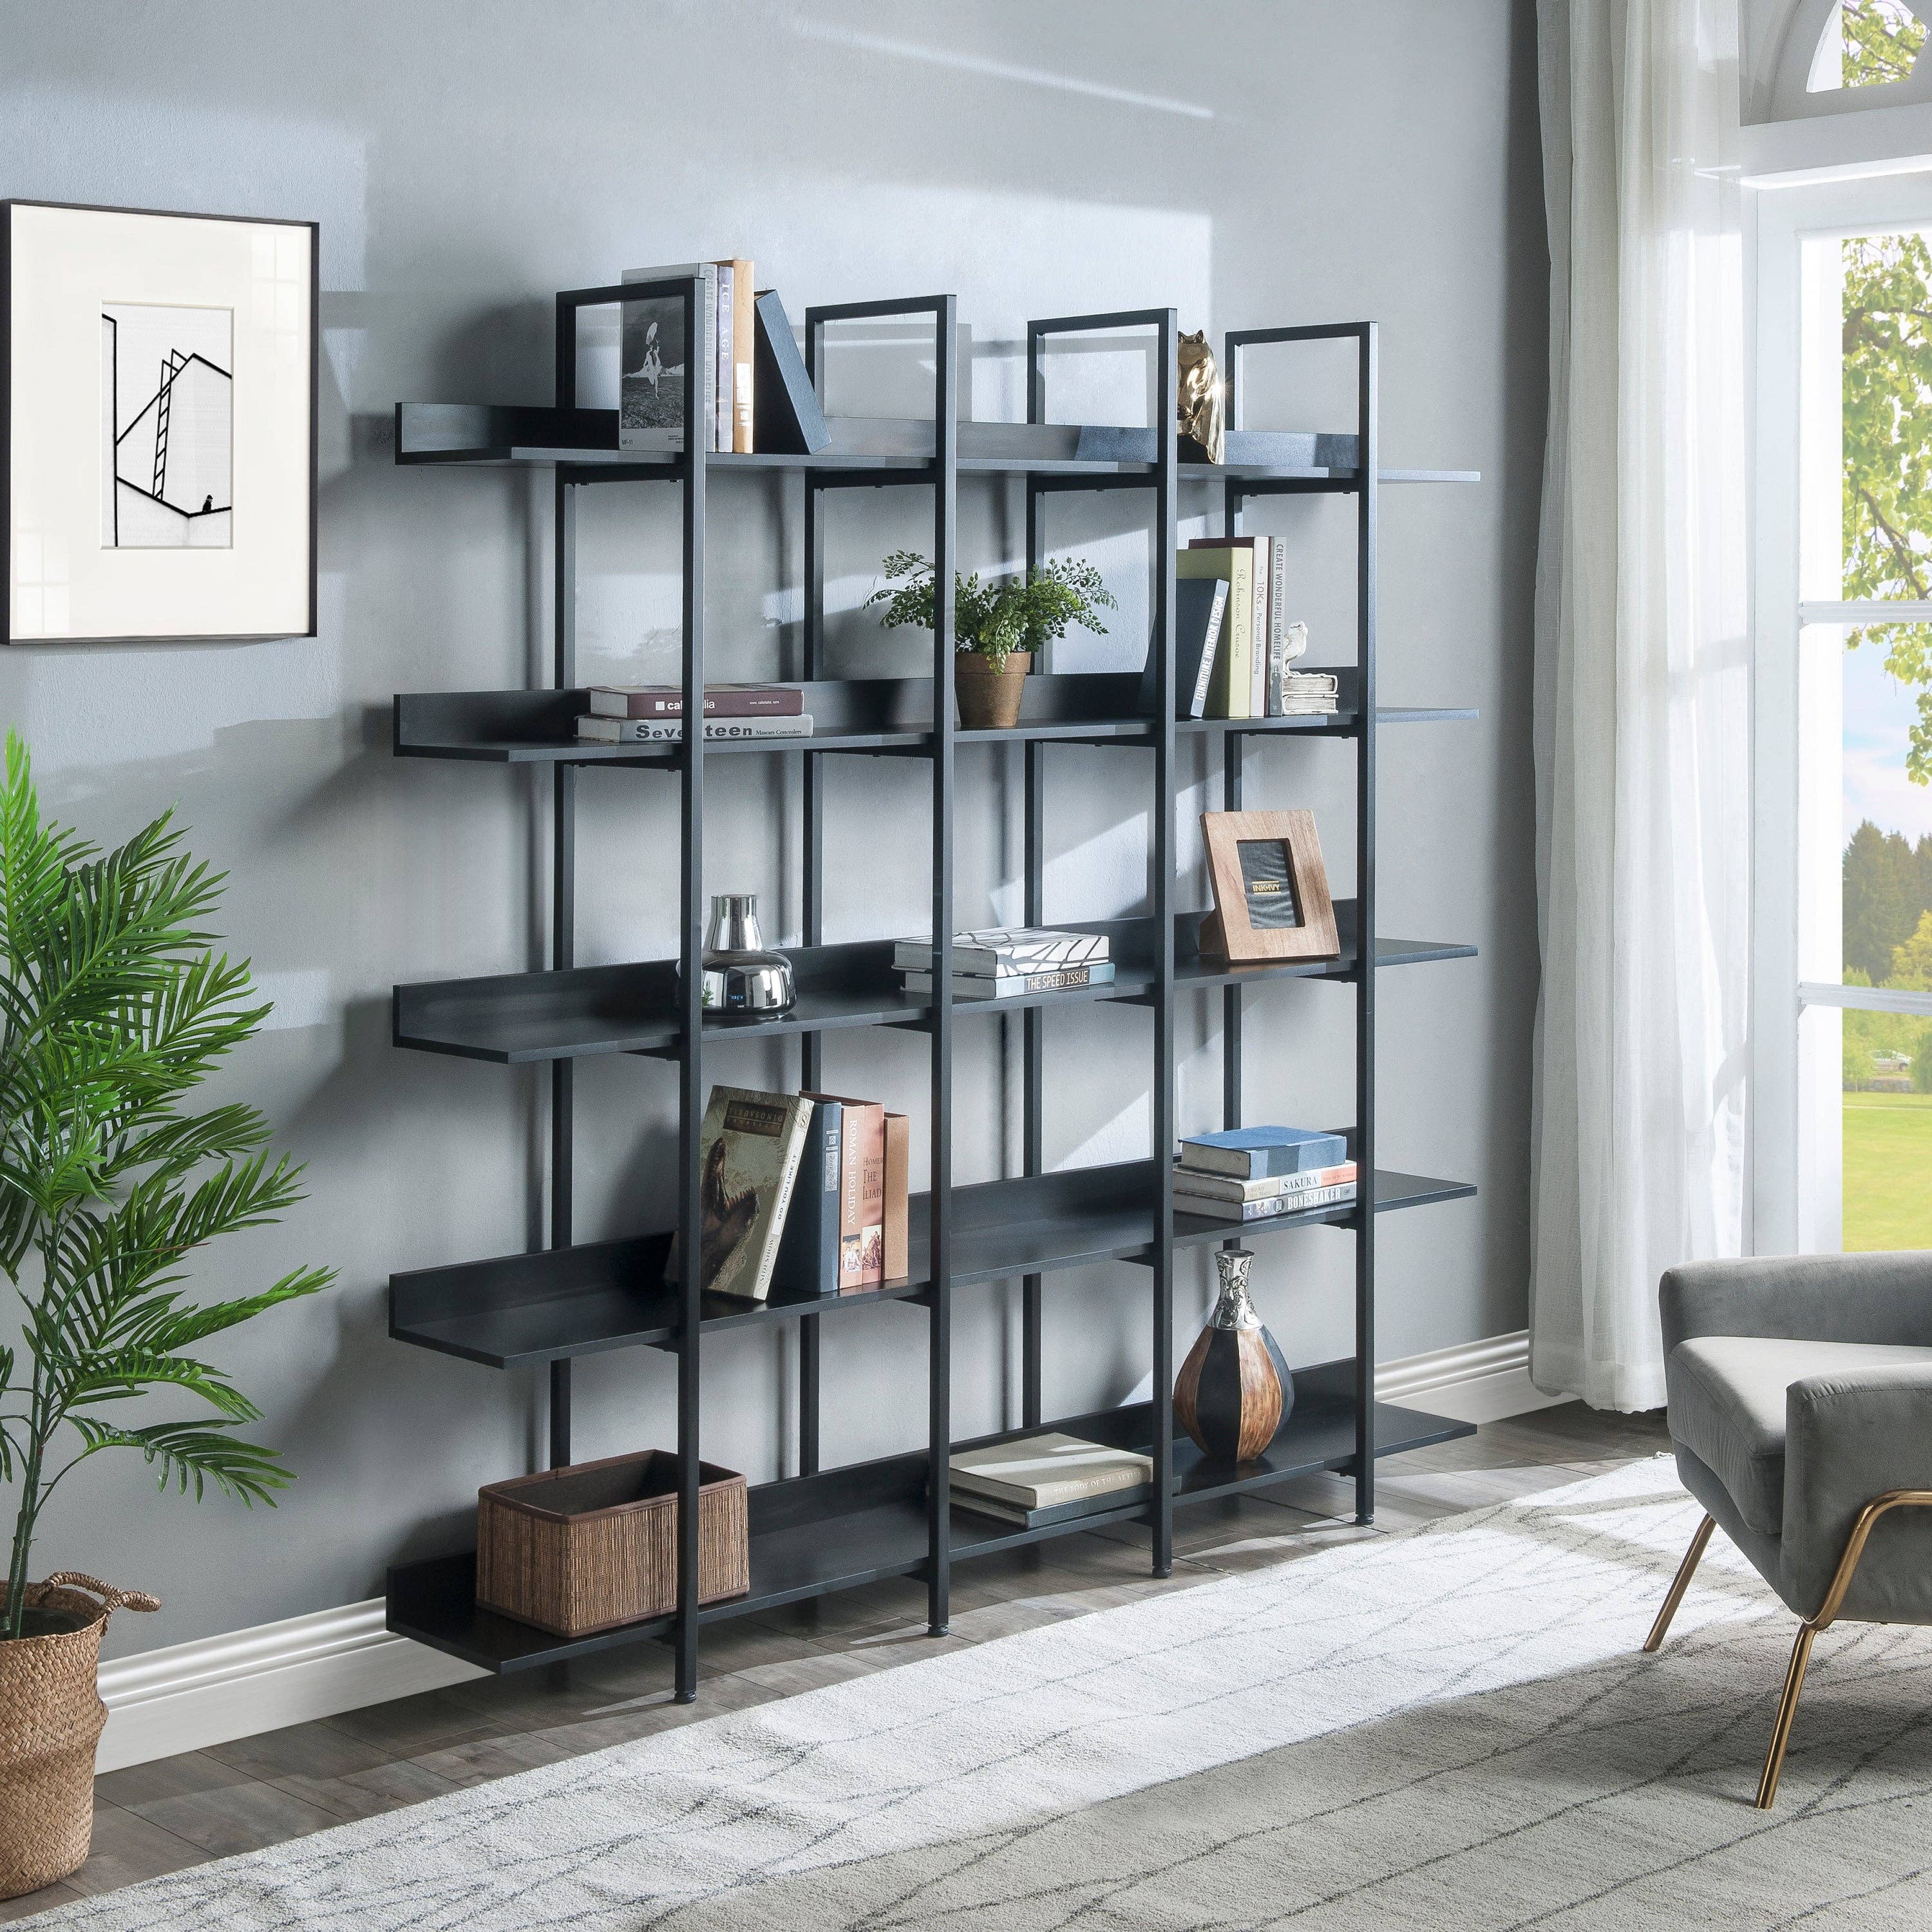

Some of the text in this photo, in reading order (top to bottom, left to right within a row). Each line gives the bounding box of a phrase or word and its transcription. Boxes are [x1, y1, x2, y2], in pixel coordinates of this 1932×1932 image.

[721, 327, 730, 360] AGE
[1274, 573, 1283, 620] WONDERFUL
[1235, 569, 1246, 659] Robinson Crusoe
[1195, 596, 1224, 701] FURNITURE INTERIOR DESIGN
[1273, 623, 1282, 659] HOMELIFE
[636, 724, 752, 739] Seveteen
[1027, 971, 1088, 990] THE SPEED ISSUE
[778, 1207, 784, 1220] DO
[792, 1154, 797, 1162] IT
[848, 1120, 857, 1225] ROMAN HOLIDAY
[864, 1169, 876, 1184] THE
[1283, 1175, 1318, 1191] SAKURA
[862, 1186, 882, 1200] ILIAD
[1288, 1187, 1341, 1209] BONESHAKER
[760, 1238, 774, 1282] SIDESHOW
[1071, 1482, 1088, 1492] BODY
